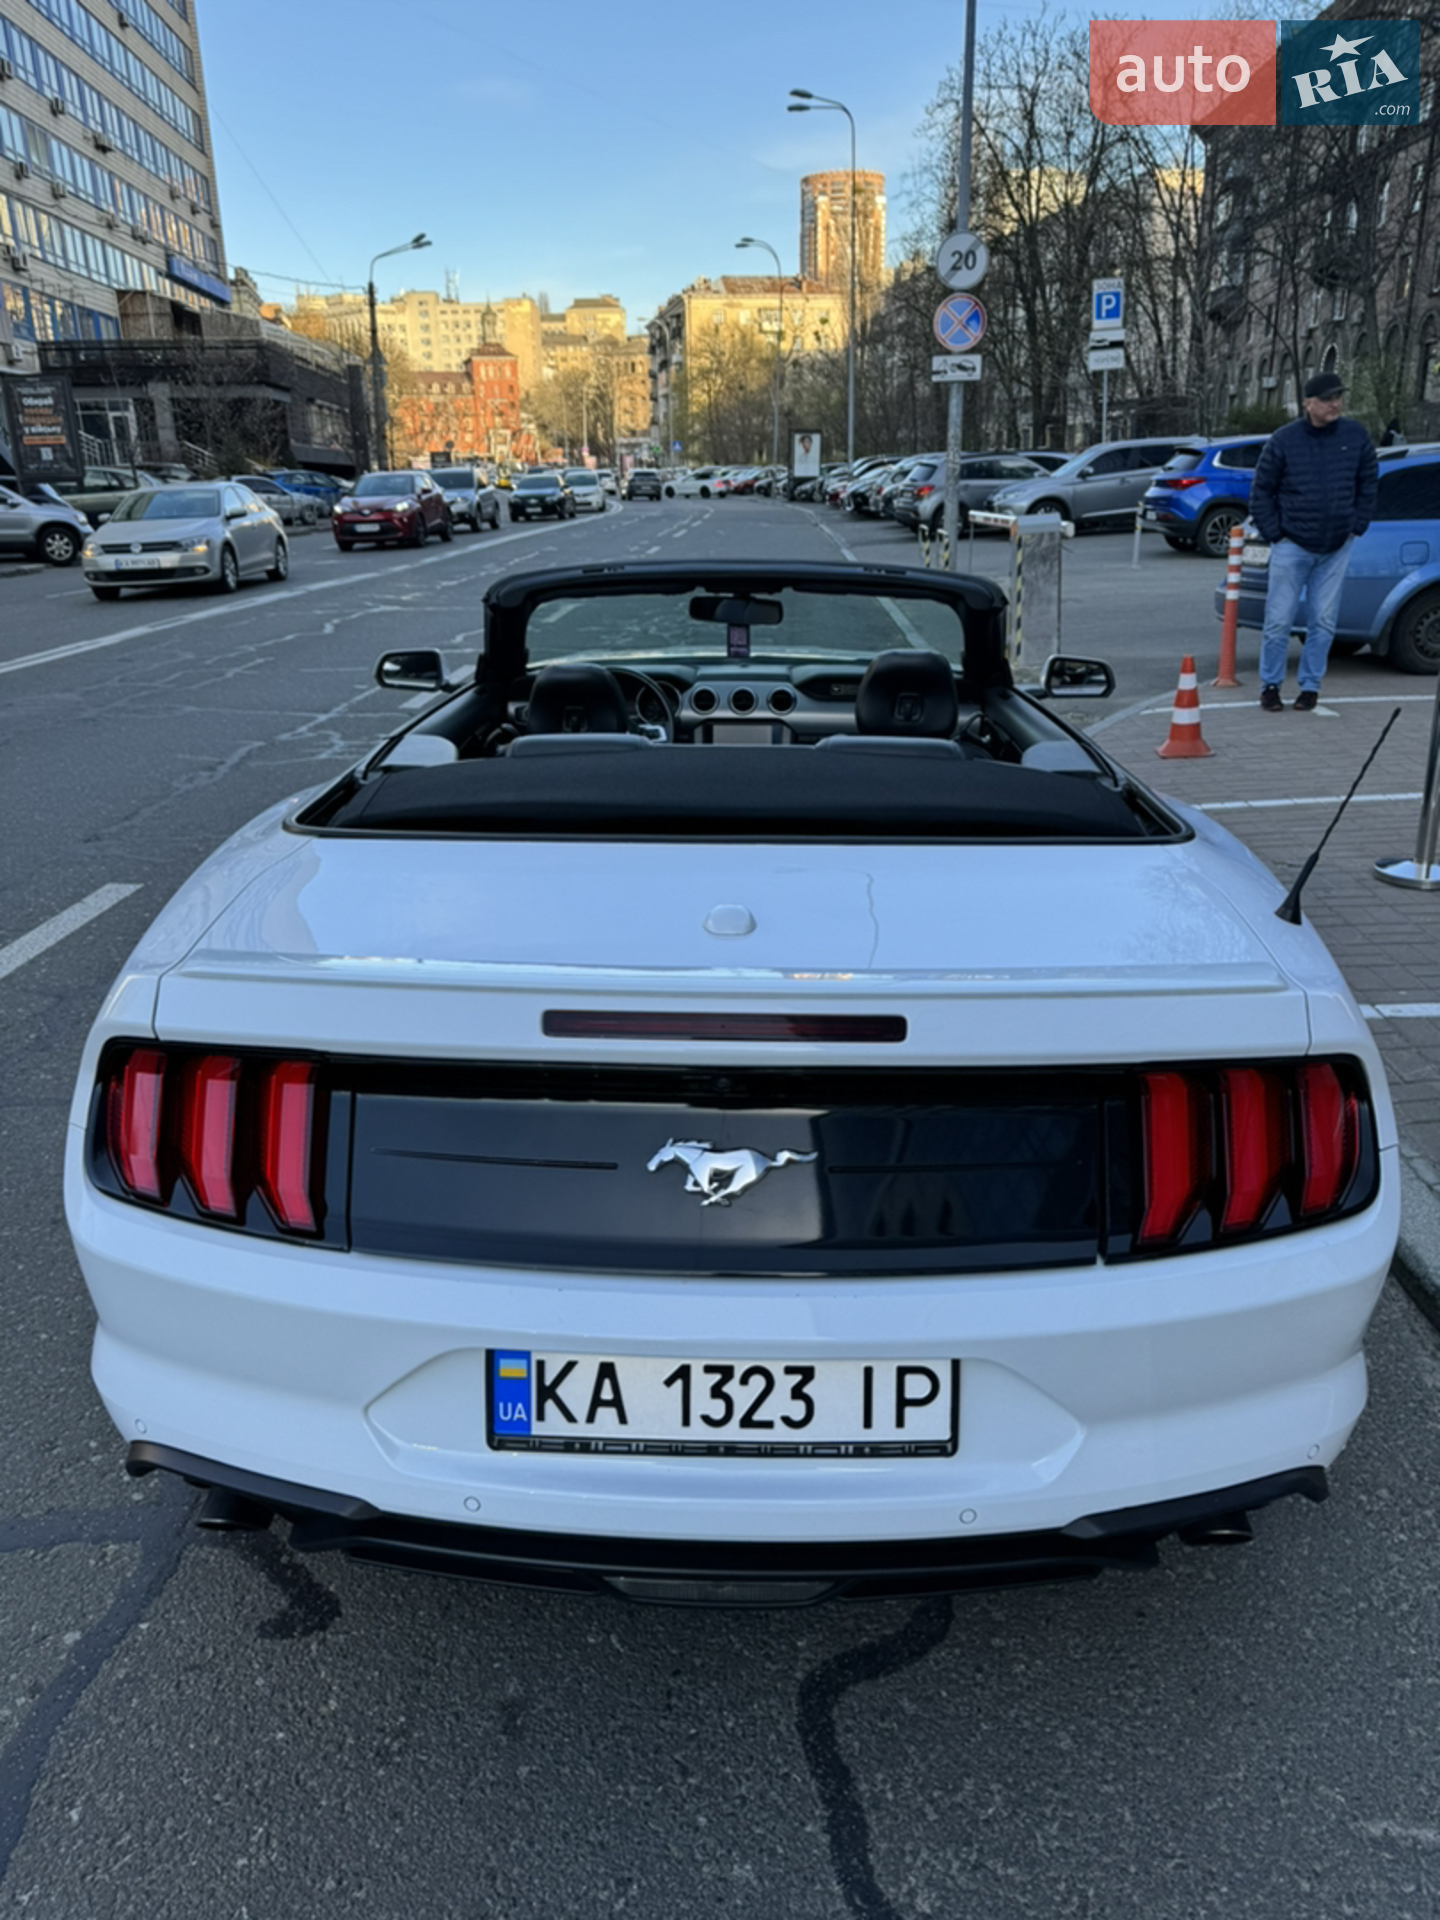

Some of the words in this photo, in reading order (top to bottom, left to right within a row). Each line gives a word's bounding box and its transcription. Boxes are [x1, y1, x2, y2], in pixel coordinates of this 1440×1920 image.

[950, 249, 977, 271] 20
[1101, 294, 1117, 319] P
[535, 1359, 628, 1425] KA
[663, 1363, 815, 1430] 1323
[862, 1365, 941, 1430] IP
[499, 1402, 528, 1422] UA
